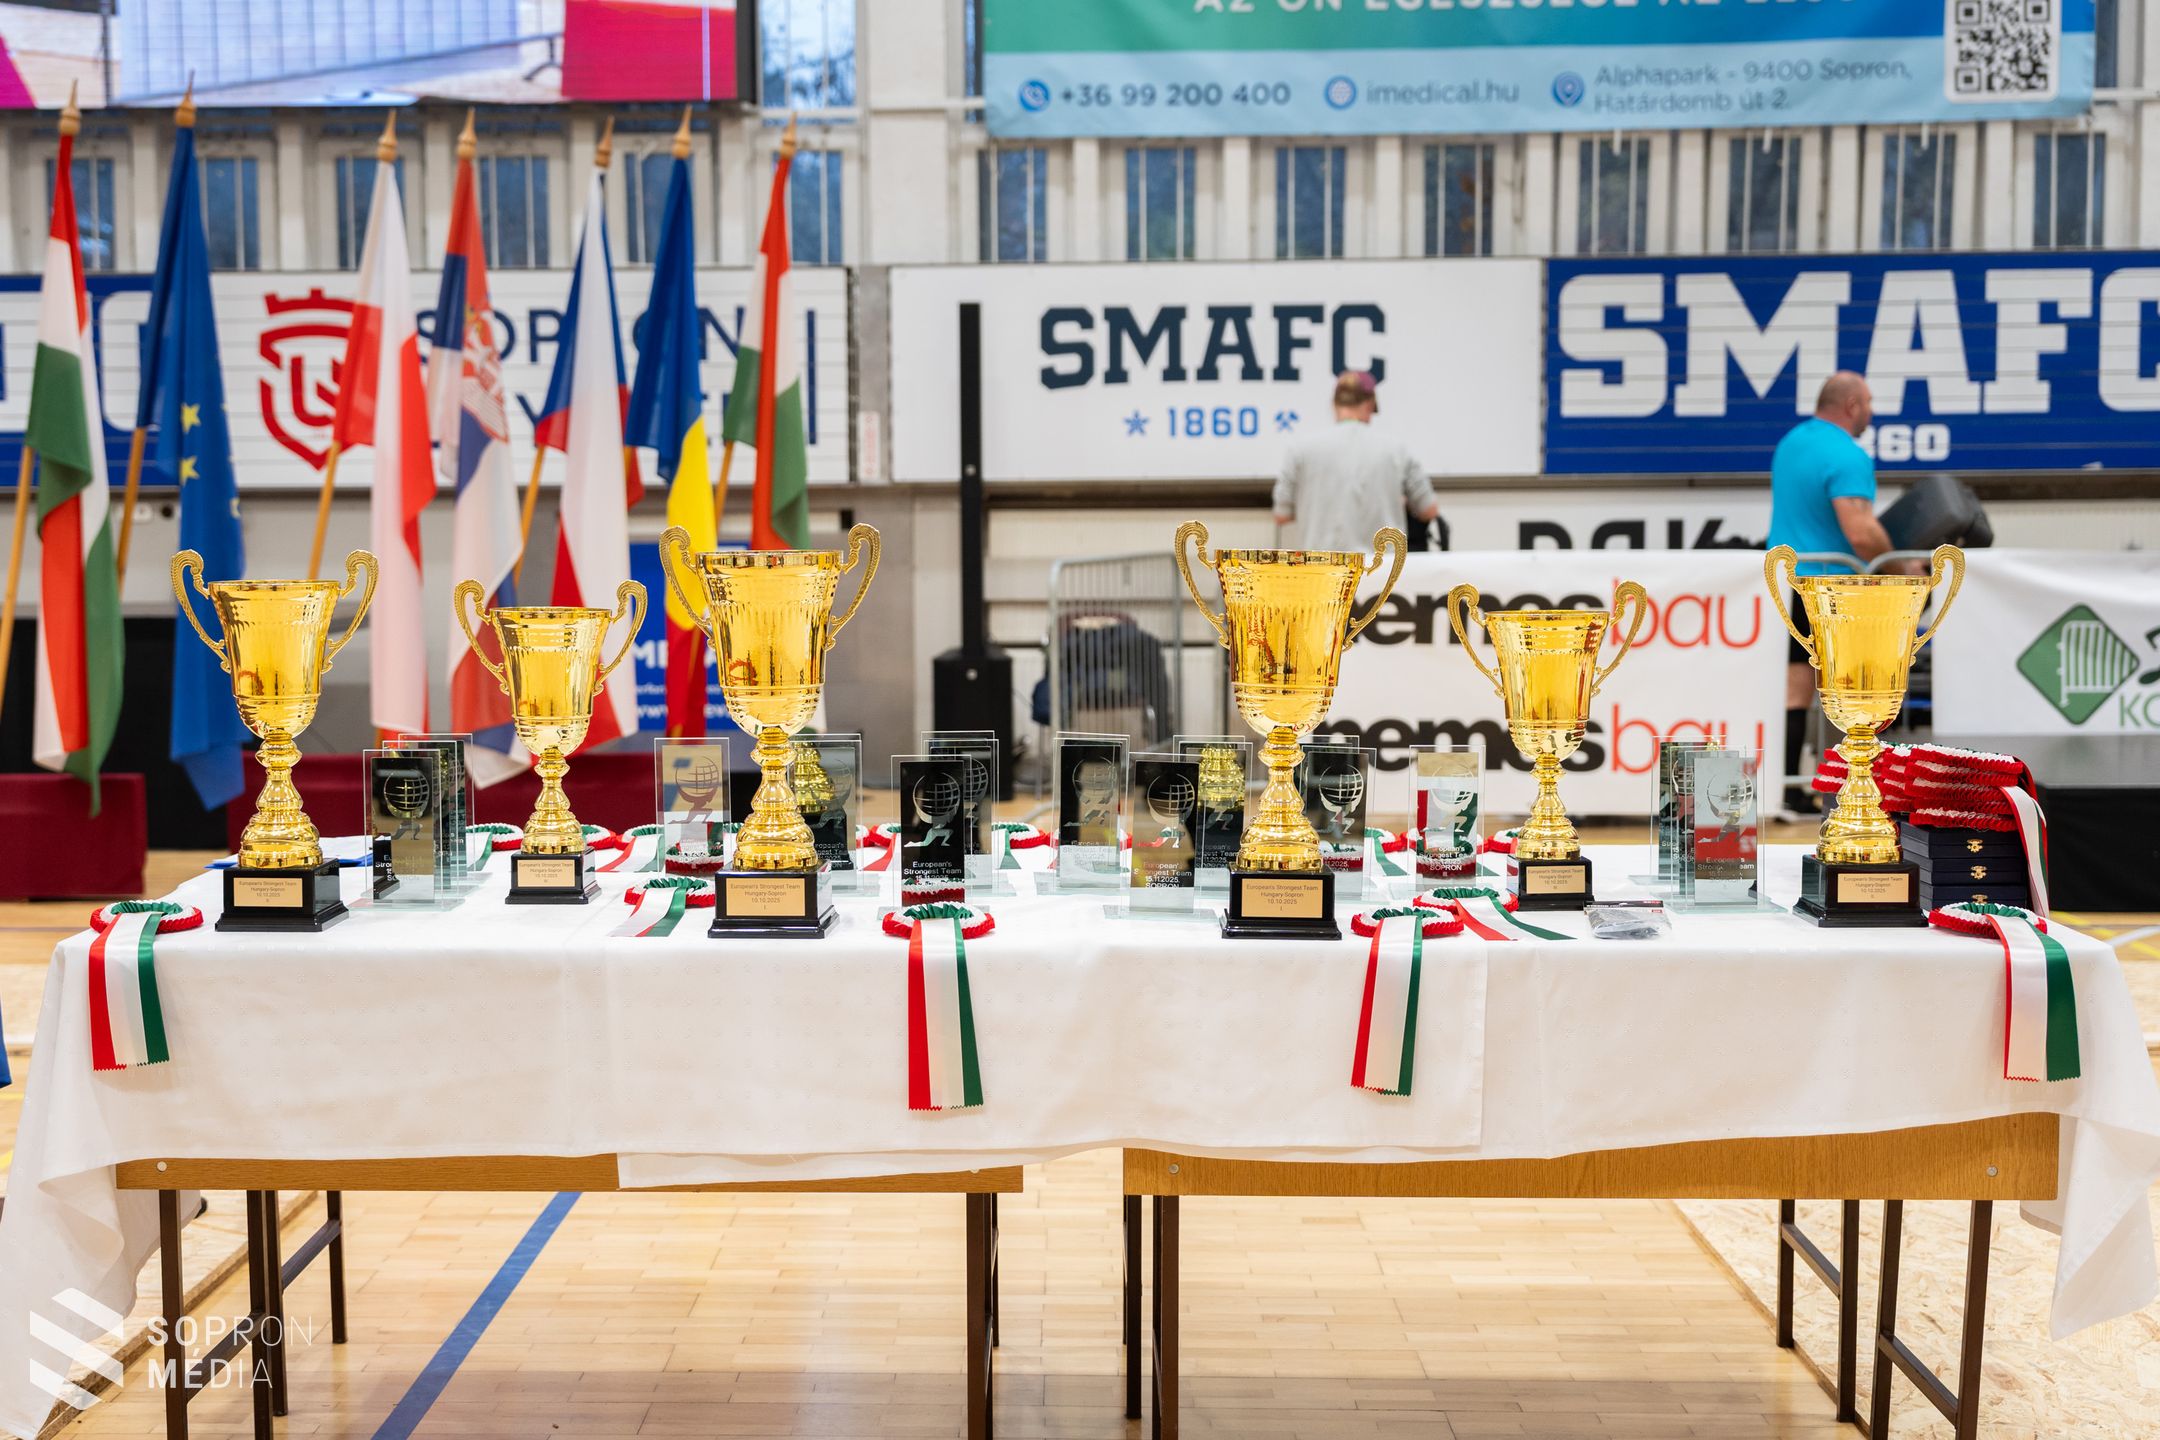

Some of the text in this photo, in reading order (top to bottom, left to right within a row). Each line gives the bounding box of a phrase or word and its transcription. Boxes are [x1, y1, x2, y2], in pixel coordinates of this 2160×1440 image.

[1595, 64, 1719, 87] Alphapark
[1742, 60, 1812, 81] 9400
[1060, 83, 1291, 107] +36 99 200 400
[1366, 80, 1519, 104] imedical.hu
[1040, 303, 1386, 389] SMAFC
[1168, 407, 1259, 437] 1860
[903, 868, 939, 876] Strongest
[912, 861, 953, 869] European's
